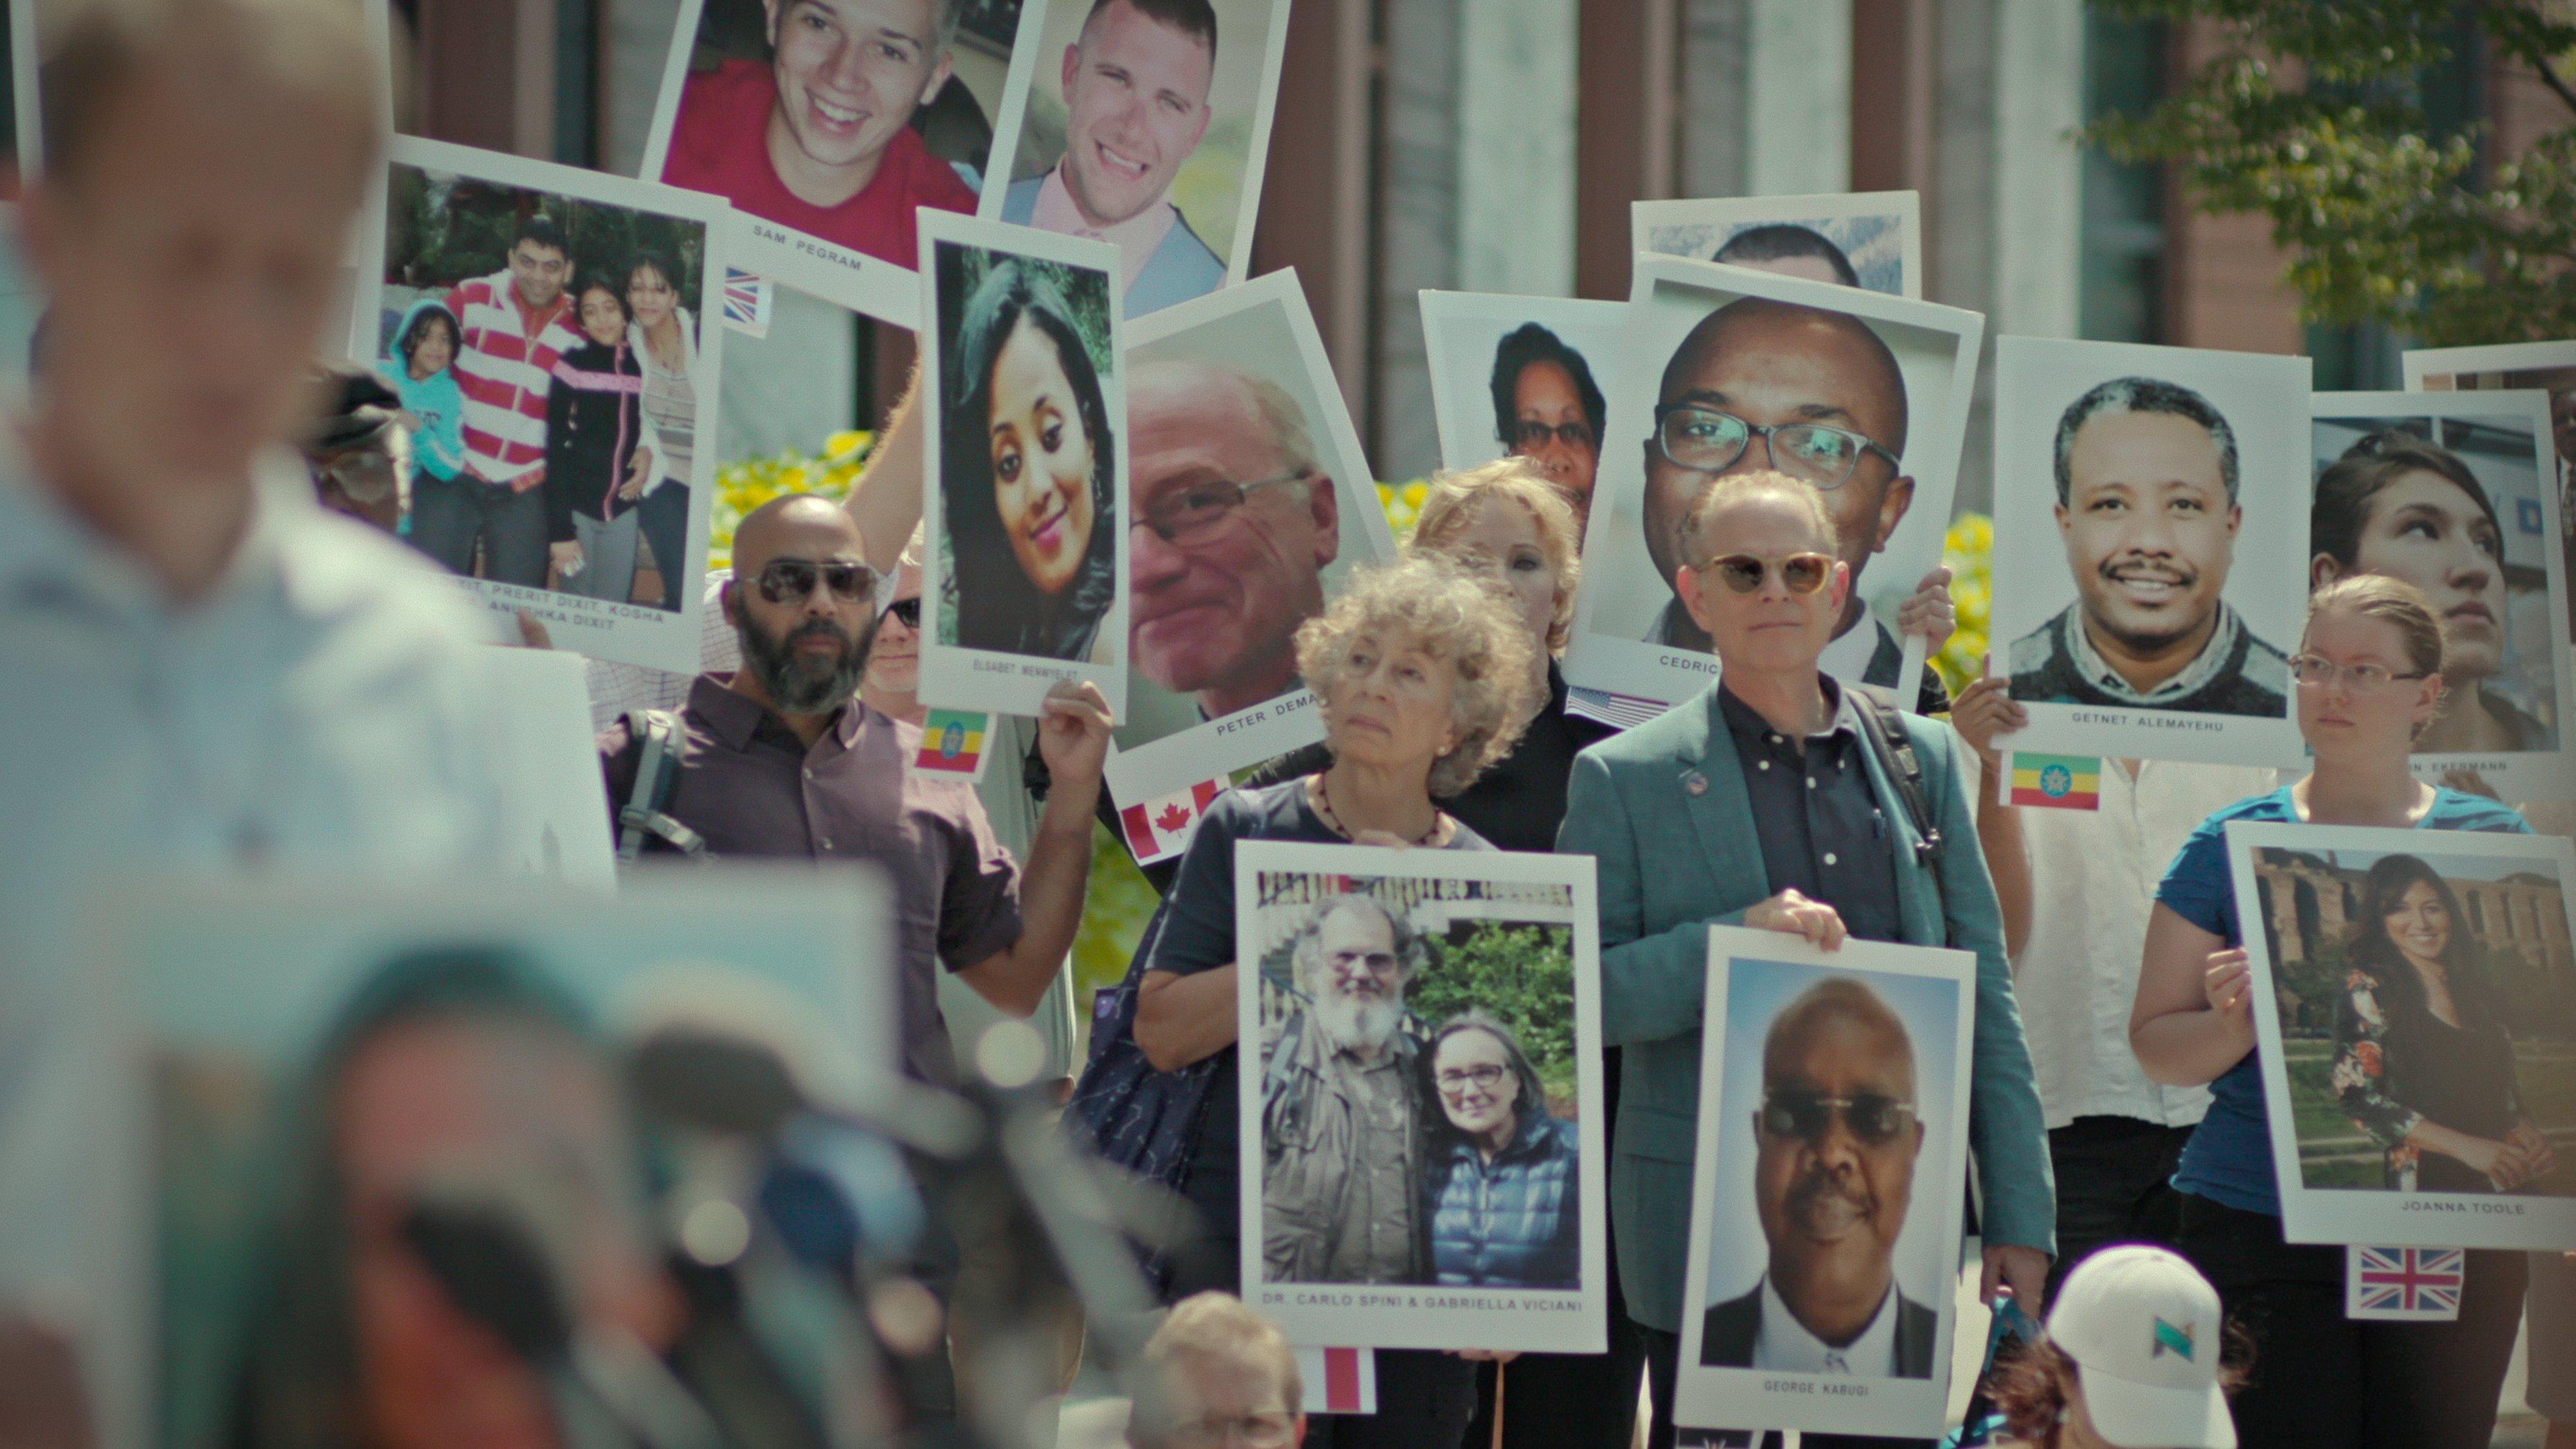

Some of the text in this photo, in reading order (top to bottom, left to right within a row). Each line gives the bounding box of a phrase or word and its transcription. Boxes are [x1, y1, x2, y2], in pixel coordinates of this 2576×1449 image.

[753, 225, 861, 270] SAM PEGRAM
[491, 586, 550, 604] PRERIT
[608, 606, 664, 624] KOSHA
[574, 615, 615, 630] DIXIT
[1659, 655, 1718, 674] CEDRIC
[1217, 711, 1266, 736] PETER
[2072, 712, 2224, 732] GETNET ALEMAYEHU
[2401, 1201, 2525, 1214] JOANNA TOOLE
[1262, 1292, 1582, 1312] DR. CARLO SPINI & GABRIELLA VICIANI
[1764, 1380, 1869, 1397] GEORGE KABUGI
